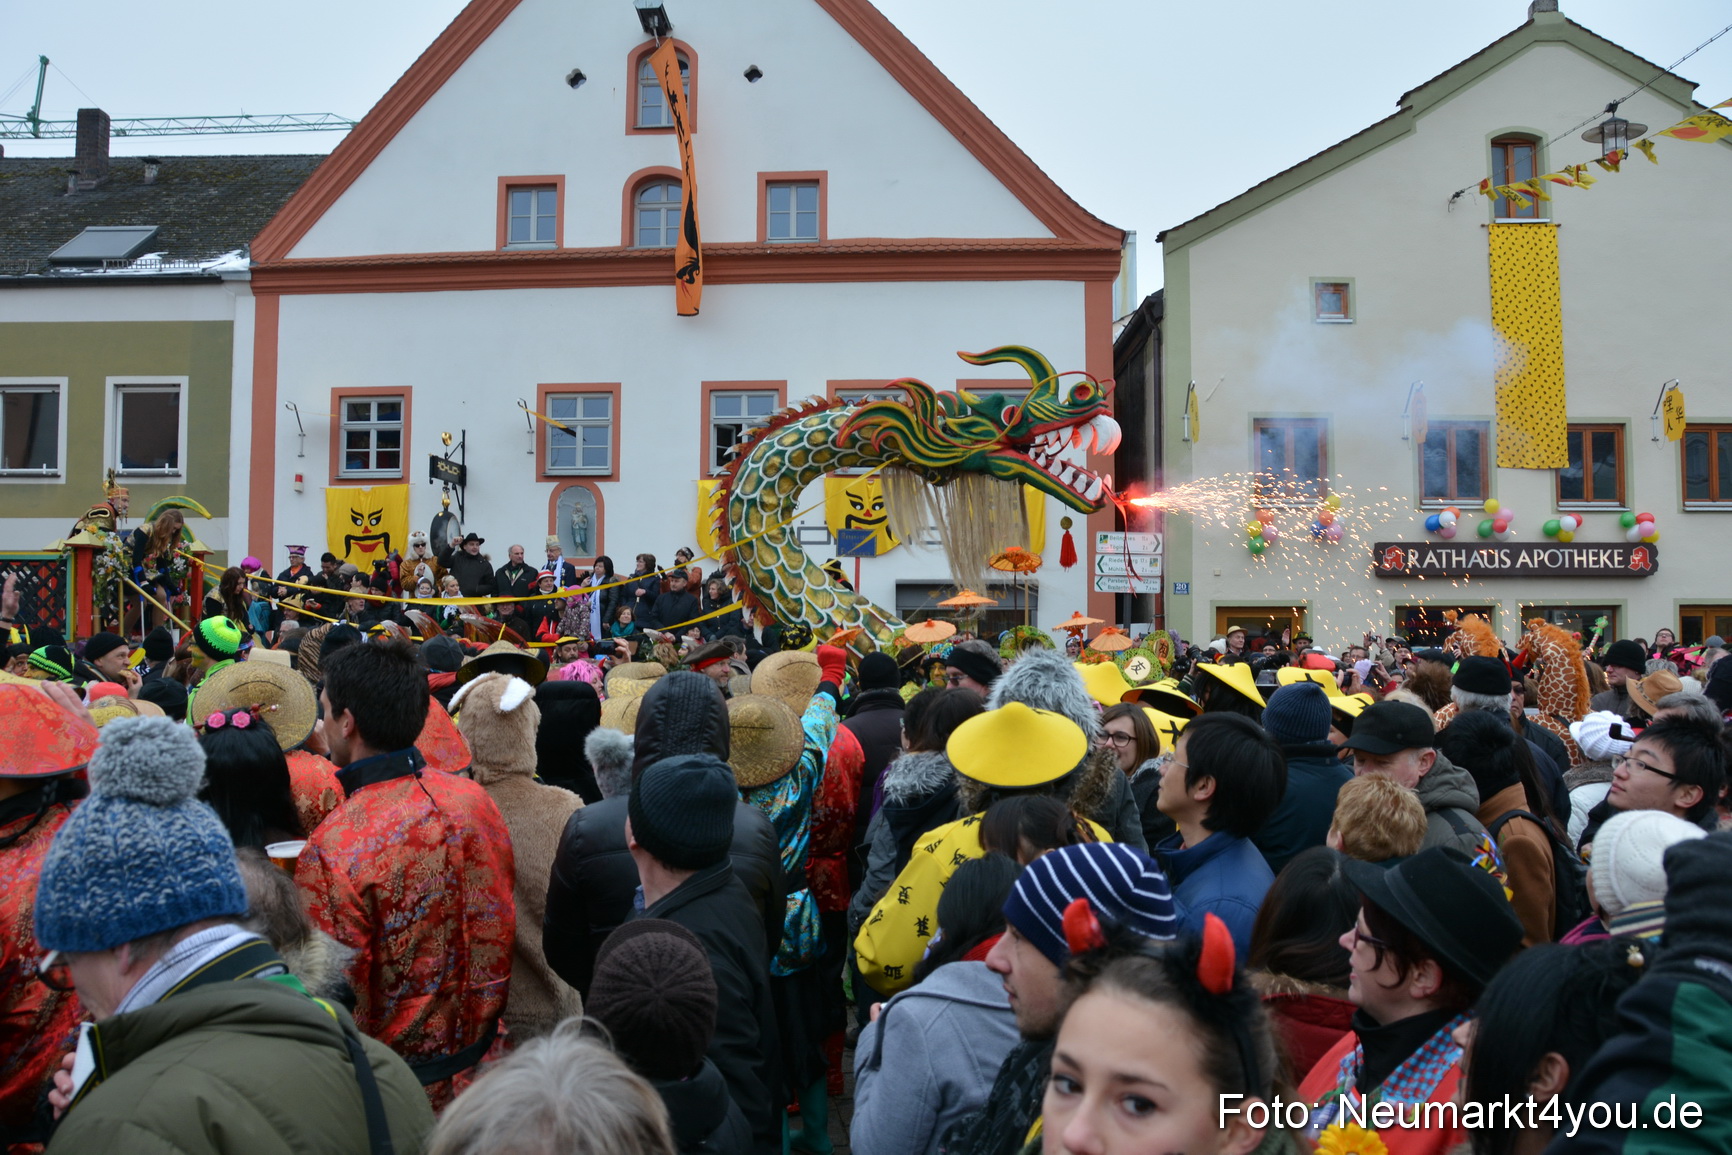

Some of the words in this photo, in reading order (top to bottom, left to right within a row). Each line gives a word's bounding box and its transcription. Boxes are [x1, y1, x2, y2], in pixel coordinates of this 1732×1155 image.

[1407, 548, 1511, 569] RATHAUS
[1515, 548, 1625, 569] APOTHEKE
[1175, 582, 1187, 591] 20
